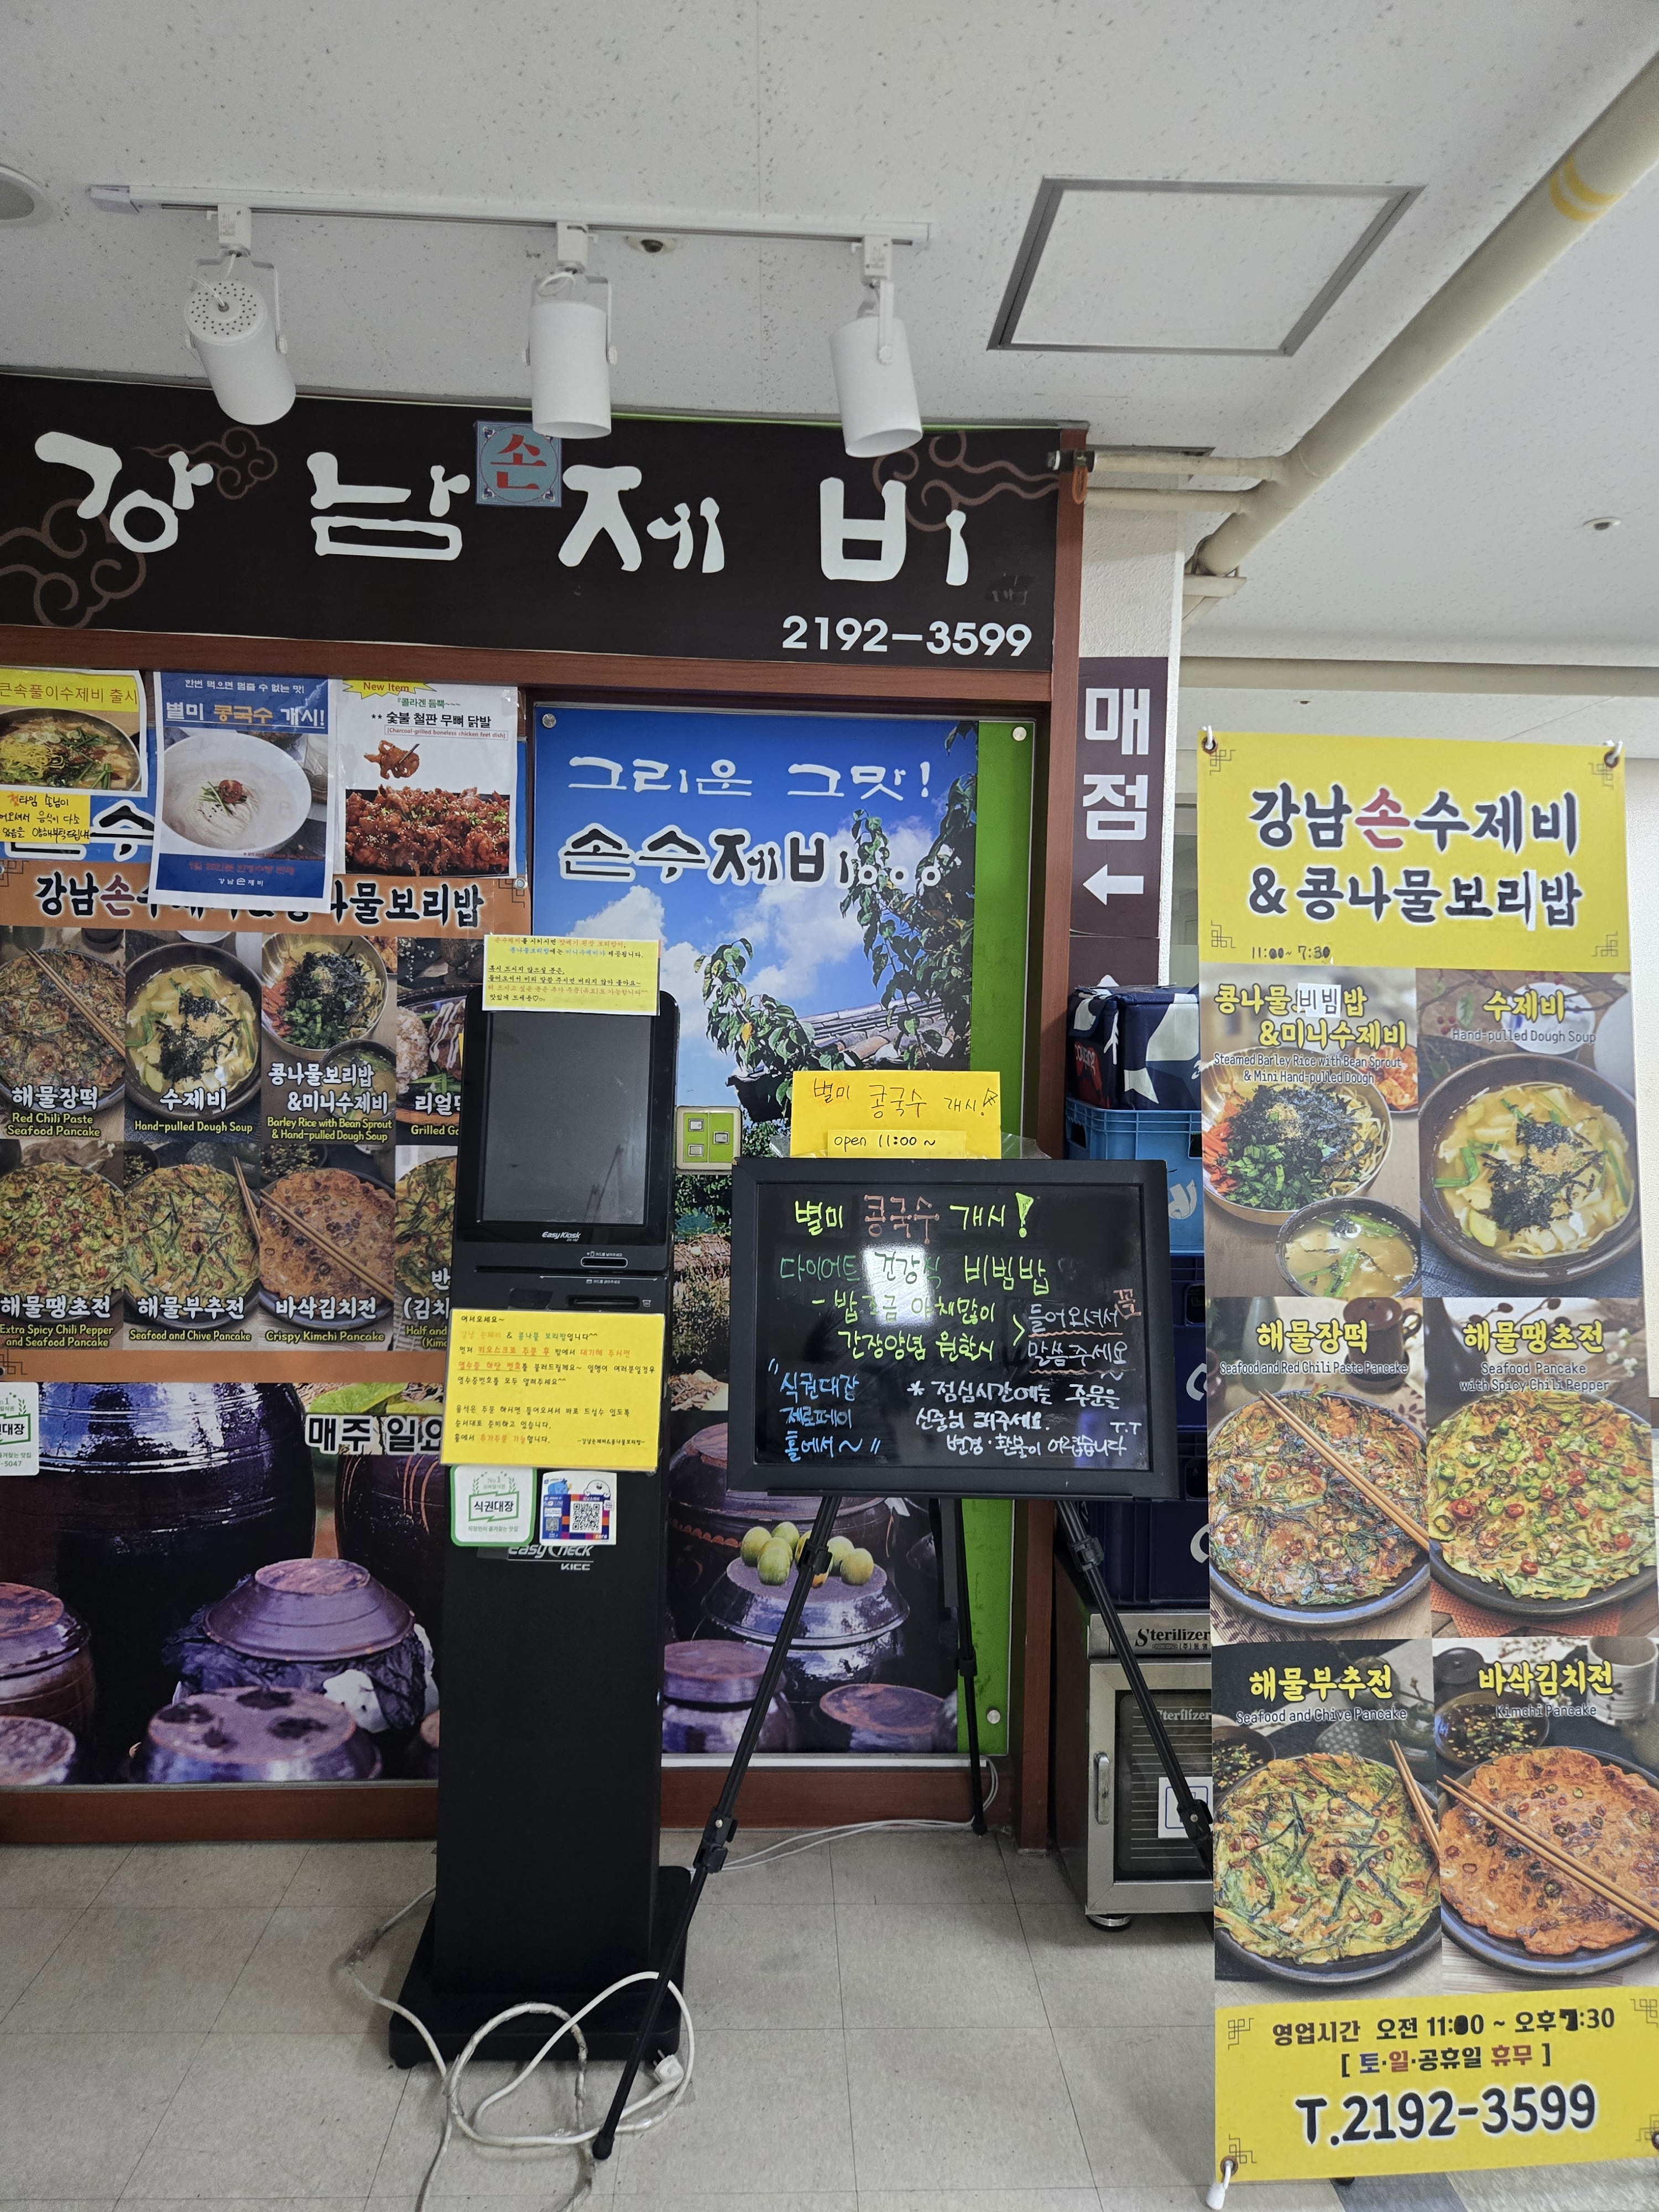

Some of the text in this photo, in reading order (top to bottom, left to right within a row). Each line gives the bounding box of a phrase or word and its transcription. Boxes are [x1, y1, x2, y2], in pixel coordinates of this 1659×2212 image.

[782, 615, 1032, 657] 2192-3599
[185, 679, 202, 688] 한번
[207, 681, 233, 690] 먹으면
[259, 683, 268, 692] 수
[272, 684, 289, 693] 없는
[363, 682, 409, 692] New Item
[109, 688, 138, 705] 출시
[166, 702, 324, 726] 별미 콩국수 개시!
[387, 711, 491, 728] 숯불 철판 무뼈 닭발
[1083, 688, 1150, 840] 매점
[568, 757, 930, 802] 그리운 그맛!
[36, 811, 80, 825] 음식이 다소
[1249, 781, 1578, 856] 강남손수제비
[1483, 989, 1566, 1024] 수제비
[1452, 1029, 1597, 1045] Hand-pulled Dough Soup
[1214, 1053, 1401, 1070] Steamed Barley Rice with Bean Sprout
[268, 1062, 375, 1088] 콩나물보리밥
[1254, 1071, 1374, 1086] Mini Hand-pulled Dough
[11, 1084, 99, 1111] 해물장떡
[159, 1087, 227, 1112] 수제비
[288, 1091, 389, 1116] &미니수제비
[813, 1077, 927, 1119] 별미 콩국수
[12, 1112, 93, 1124] Red Chili Paste
[268, 1117, 392, 1130] Barley Rice with Bean Sprout
[7, 1125, 100, 1137] Seafood Pancake
[134, 1120, 253, 1135] Hand-pulled Dough Soup
[411, 1125, 448, 1136] Grilled
[281, 1130, 388, 1144] Hand-pulled Dough Soup
[834, 1135, 917, 1152] open 11:00
[795, 1192, 1034, 1245] 별미 콩국수 개시!
[780, 1253, 860, 1282] 다이어트
[964, 1254, 1050, 1295] 비빔밥
[0, 1295, 111, 1319] 해물땡초전
[137, 1295, 245, 1320] 해물부추전
[275, 1295, 378, 1321] 바삭김치전
[0, 1324, 113, 1337] Extra Spicy Chili Pepper
[129, 1329, 252, 1342] Seafood and Chive Pancake
[266, 1331, 385, 1344] Crispy Kimchi Pancake
[406, 1326, 426, 1335] Half
[518, 1332, 539, 1341] 콩나물
[1256, 1318, 1369, 1355] 해물장떡
[1462, 1319, 1605, 1355] 해물땡초전
[6, 1337, 109, 1347] and Seafood Pancake
[522, 1347, 537, 1355] 주문
[542, 1347, 550, 1355] 후
[581, 1349, 603, 1357] 대기해
[608, 1349, 630, 1358] 주시면
[458, 1361, 480, 1370] 영수증
[1220, 1361, 1408, 1374] Seafood and Red Chili Paste Pancake
[1481, 1362, 1587, 1374] Seafood Pancake
[780, 1371, 859, 1403] 식권대장
[932, 1380, 1120, 1409] 점심시간에는 주문을
[1460, 1379, 1609, 1393] with Spicy Chili Pepper
[456, 1405, 495, 1414] 음식은 주문
[474, 1500, 514, 1512] 식권대장
[1135, 1629, 1210, 1647] Sterilizer
[1249, 1664, 1394, 1702] 해물부추전
[1478, 1660, 1614, 1697] 바삭김치전
[1236, 1707, 1407, 1724] Seafood and Chive Pancake
[1496, 1703, 1597, 1718] Kimchi Pancake
[1271, 2019, 1361, 2047] 영업시간
[1376, 2017, 1419, 2041] 오전
[1490, 2043, 1533, 2067] 휴무
[1295, 2082, 1597, 2147] T.2192-3599
